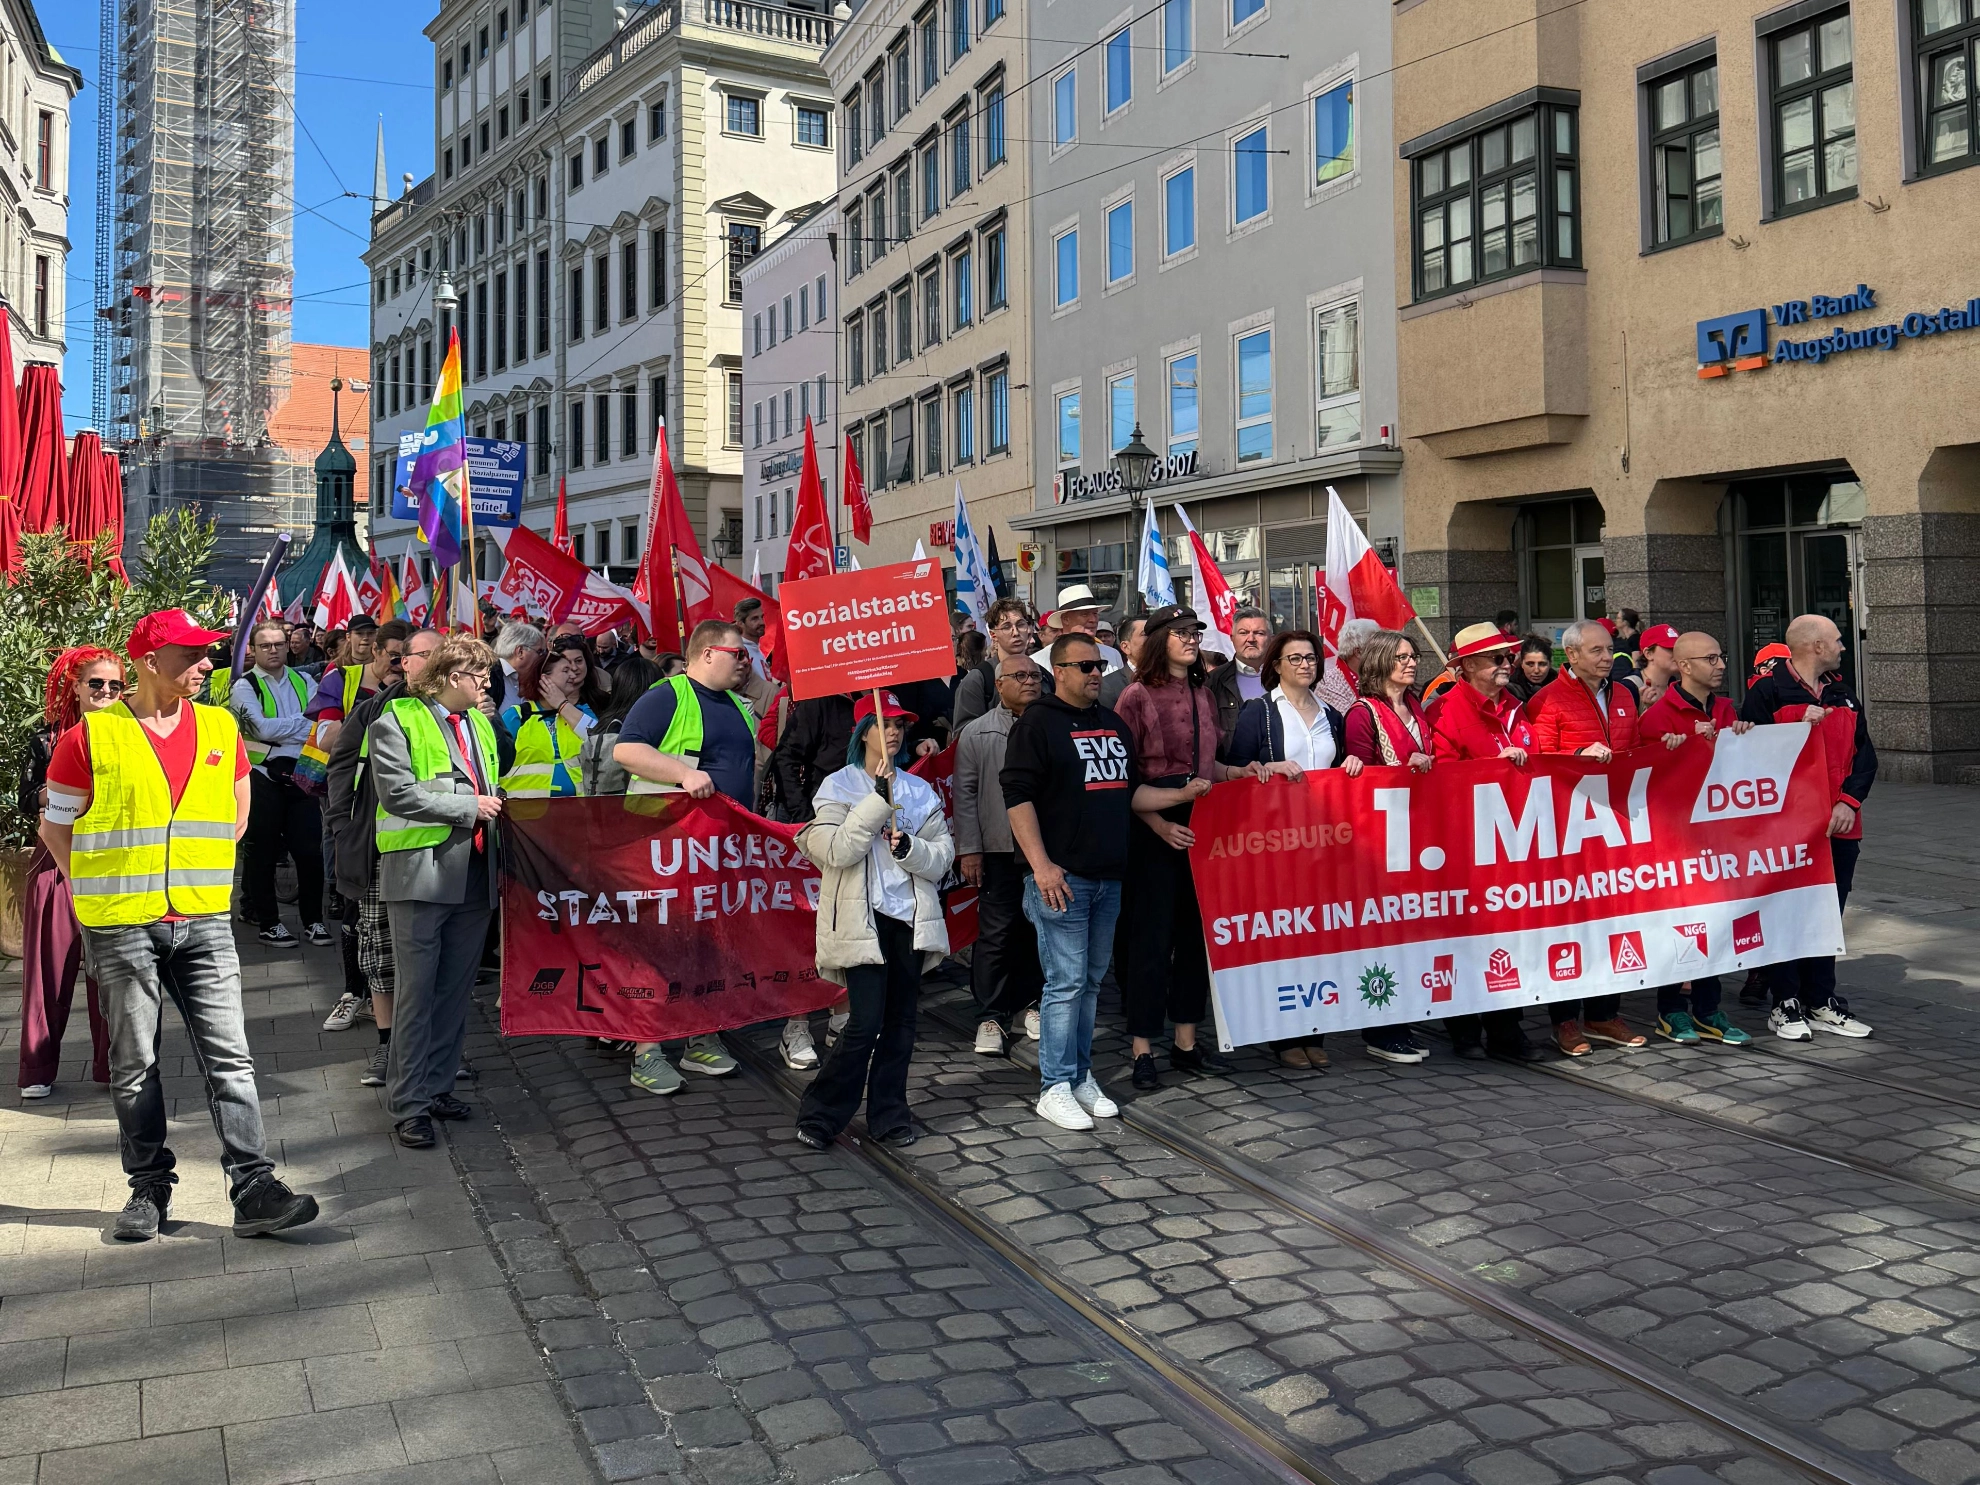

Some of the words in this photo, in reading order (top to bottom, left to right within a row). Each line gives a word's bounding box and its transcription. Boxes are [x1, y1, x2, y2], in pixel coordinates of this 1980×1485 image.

[1772, 300, 1808, 326] VR
[1811, 284, 1876, 319] Bank
[1070, 475, 1086, 497] FC
[1163, 451, 1197, 480] 1907
[471, 501, 503, 512] rofite!
[838, 548, 848, 565] P
[786, 590, 943, 631] Sozialstaats-
[821, 621, 916, 655] retterin
[1073, 736, 1128, 759] EVG
[1084, 758, 1129, 782] AUX
[1706, 777, 1779, 813] DGB
[1374, 787, 1446, 873] 1.
[1474, 766, 1653, 866] MAI
[1208, 821, 1353, 860] AUGSBURG
[537, 889, 678, 926] STATT
[693, 877, 797, 922] EURE
[1213, 905, 1316, 945] STARK
[1322, 901, 1354, 931] IN
[1360, 889, 1479, 926] ARBEIT.
[1485, 860, 1678, 912] SOLIDARISCH
[1682, 849, 1739, 885] FÜR
[1747, 843, 1814, 877] ALLE.
[1683, 923, 1707, 936] NGG
[533, 981, 555, 990] DGB
[1420, 968, 1458, 989] GEW
[1555, 968, 1576, 978] IGBCE
[1278, 980, 1340, 1011] EVG
